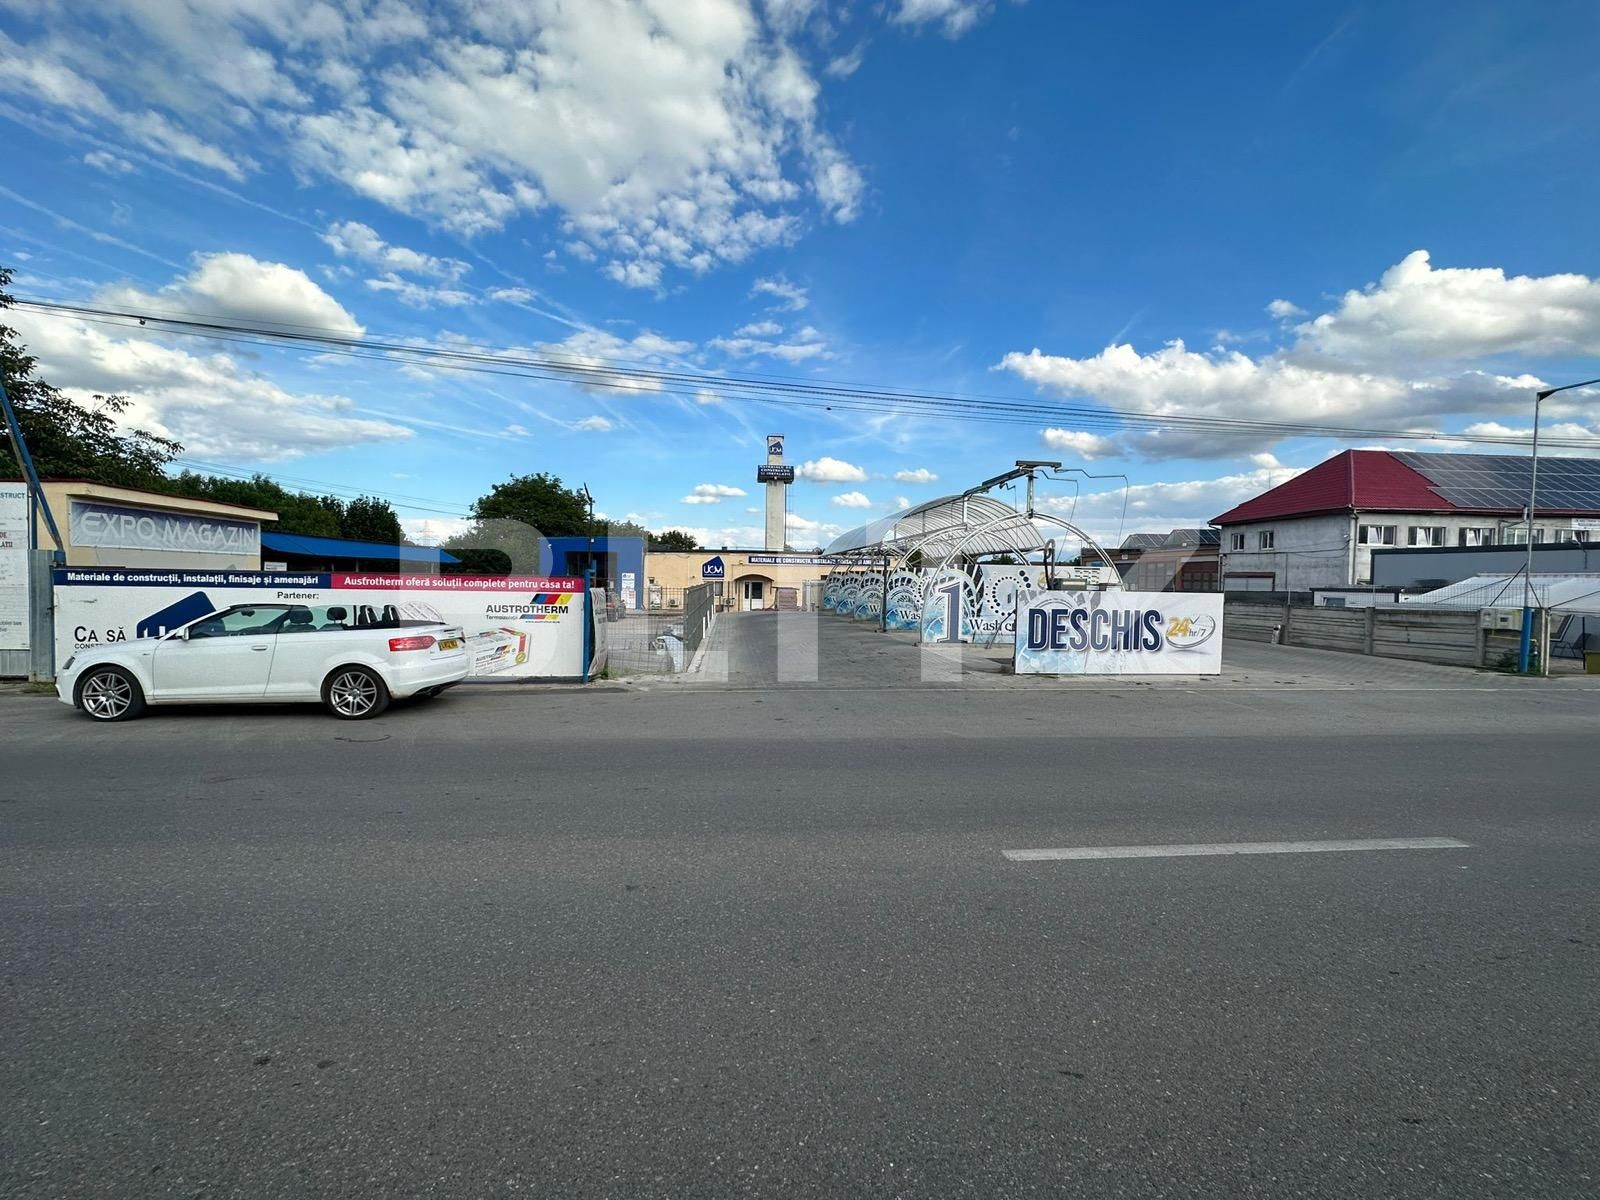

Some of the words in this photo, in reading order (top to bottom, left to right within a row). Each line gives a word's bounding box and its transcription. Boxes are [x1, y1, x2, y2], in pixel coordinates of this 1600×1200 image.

[81, 511, 155, 540] EXPO
[162, 519, 255, 546] MAGAZIN
[67, 572, 110, 581] Materiale
[113, 573, 125, 581] de
[127, 573, 181, 584] construcții,
[228, 575, 261, 585] finisaje
[263, 575, 272, 585] și
[274, 575, 319, 585] amenajări
[344, 577, 404, 586] Austrotherm
[405, 577, 430, 587] oferă
[432, 577, 462, 588] soluții
[464, 578, 506, 589] complete
[508, 580, 538, 589] pentru
[540, 581, 561, 589] casa
[562, 580, 575, 589] ta!
[277, 591, 320, 599] Partener:
[486, 604, 569, 614] AUSTROTHERM
[900, 610, 921, 620] Was
[969, 619, 1002, 631] Wash
[1027, 608, 1162, 651] DESCHIS
